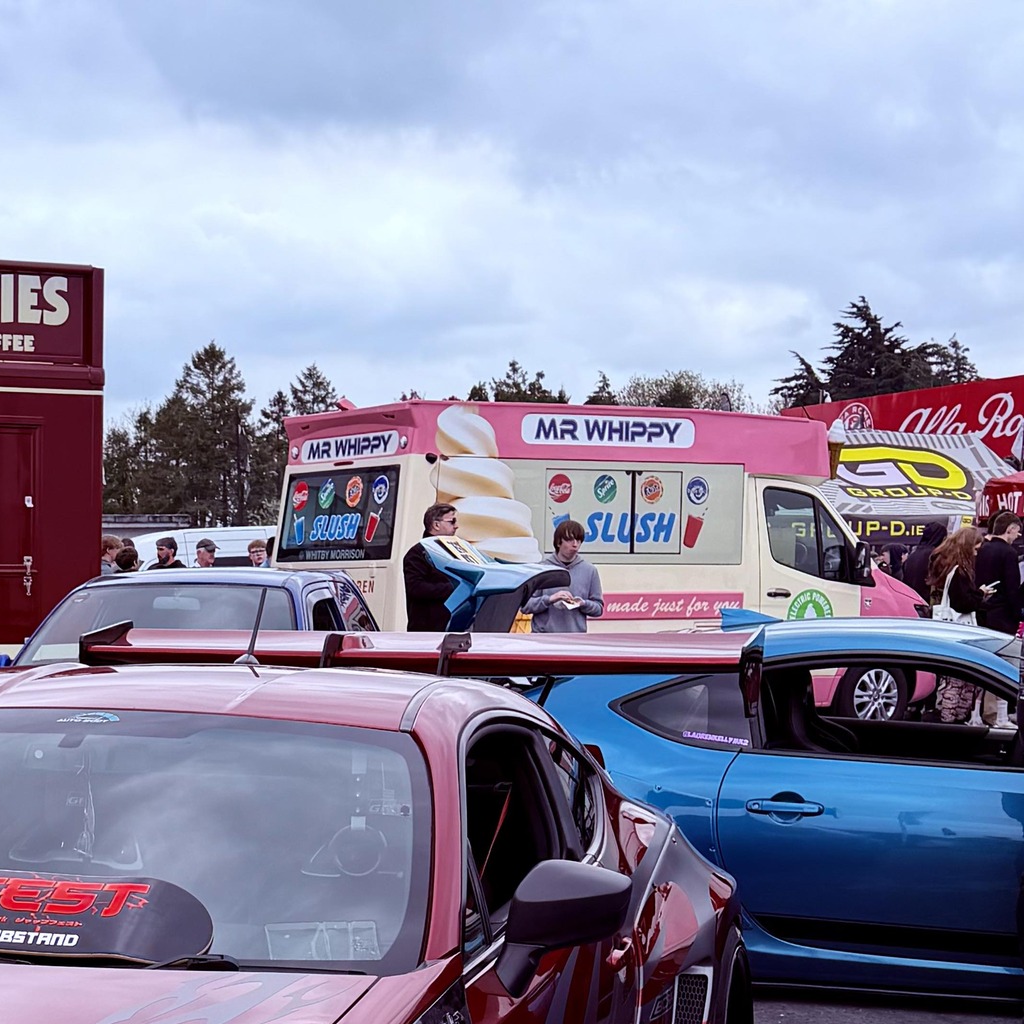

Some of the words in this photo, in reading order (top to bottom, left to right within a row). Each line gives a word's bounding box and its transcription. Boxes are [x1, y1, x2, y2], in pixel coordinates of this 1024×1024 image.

[534, 417, 580, 441] MR
[584, 418, 682, 444] WHIPPY
[307, 439, 331, 460] MR
[335, 433, 393, 458] WHIPPY
[846, 486, 972, 500] GROUP-D
[996, 491, 1023, 514] HOT
[309, 513, 361, 541] SLUSH
[584, 511, 676, 544] SLUSH
[305, 549, 330, 560] WHITBY
[330, 548, 366, 559] MORRISON
[607, 597, 649, 612] made
[652, 598, 684, 617] just
[686, 596, 709, 617] for
[713, 600, 741, 615] you
